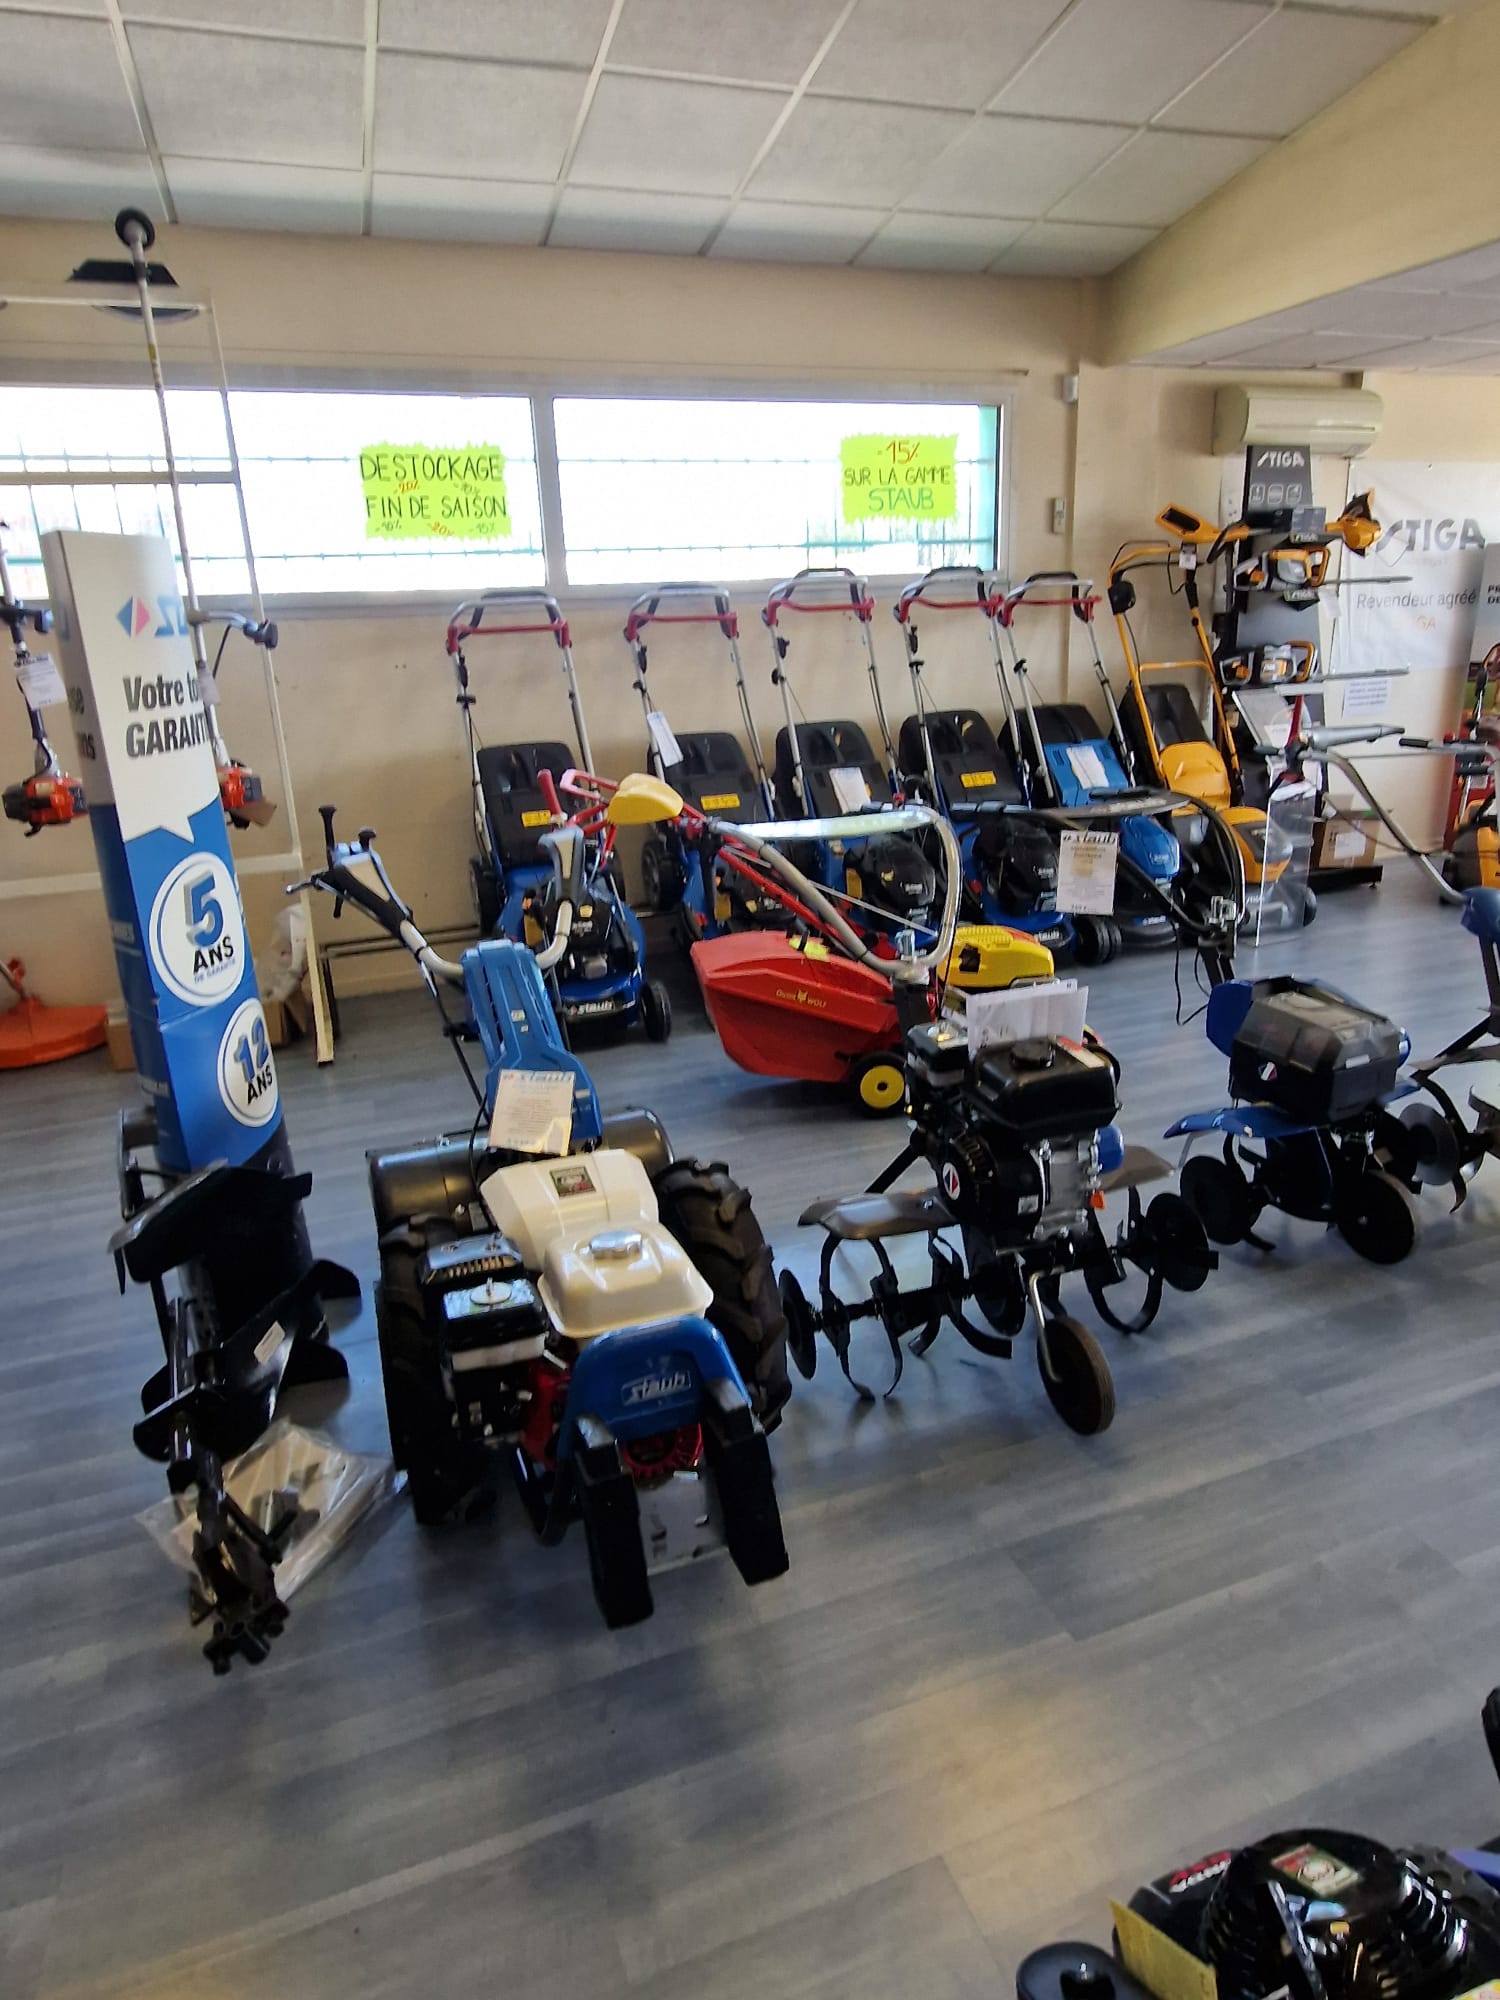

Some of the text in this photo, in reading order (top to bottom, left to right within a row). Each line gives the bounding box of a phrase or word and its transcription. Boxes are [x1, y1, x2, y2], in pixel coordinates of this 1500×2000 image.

[360, 454, 503, 481] DESTOCKAGE
[1257, 451, 1304, 467] STIGA
[844, 465, 951, 486] SUR LA GAMME
[366, 495, 507, 519] FIN DE SAISON
[868, 487, 934, 512] STAUB
[1376, 518, 1485, 552] STIGA
[1357, 588, 1476, 608] Revendeur agréé
[123, 675, 184, 712] Votre
[184, 872, 225, 948] 5
[193, 936, 235, 976] ANS
[234, 1016, 270, 1082] 12
[247, 1065, 274, 1106] ANS
